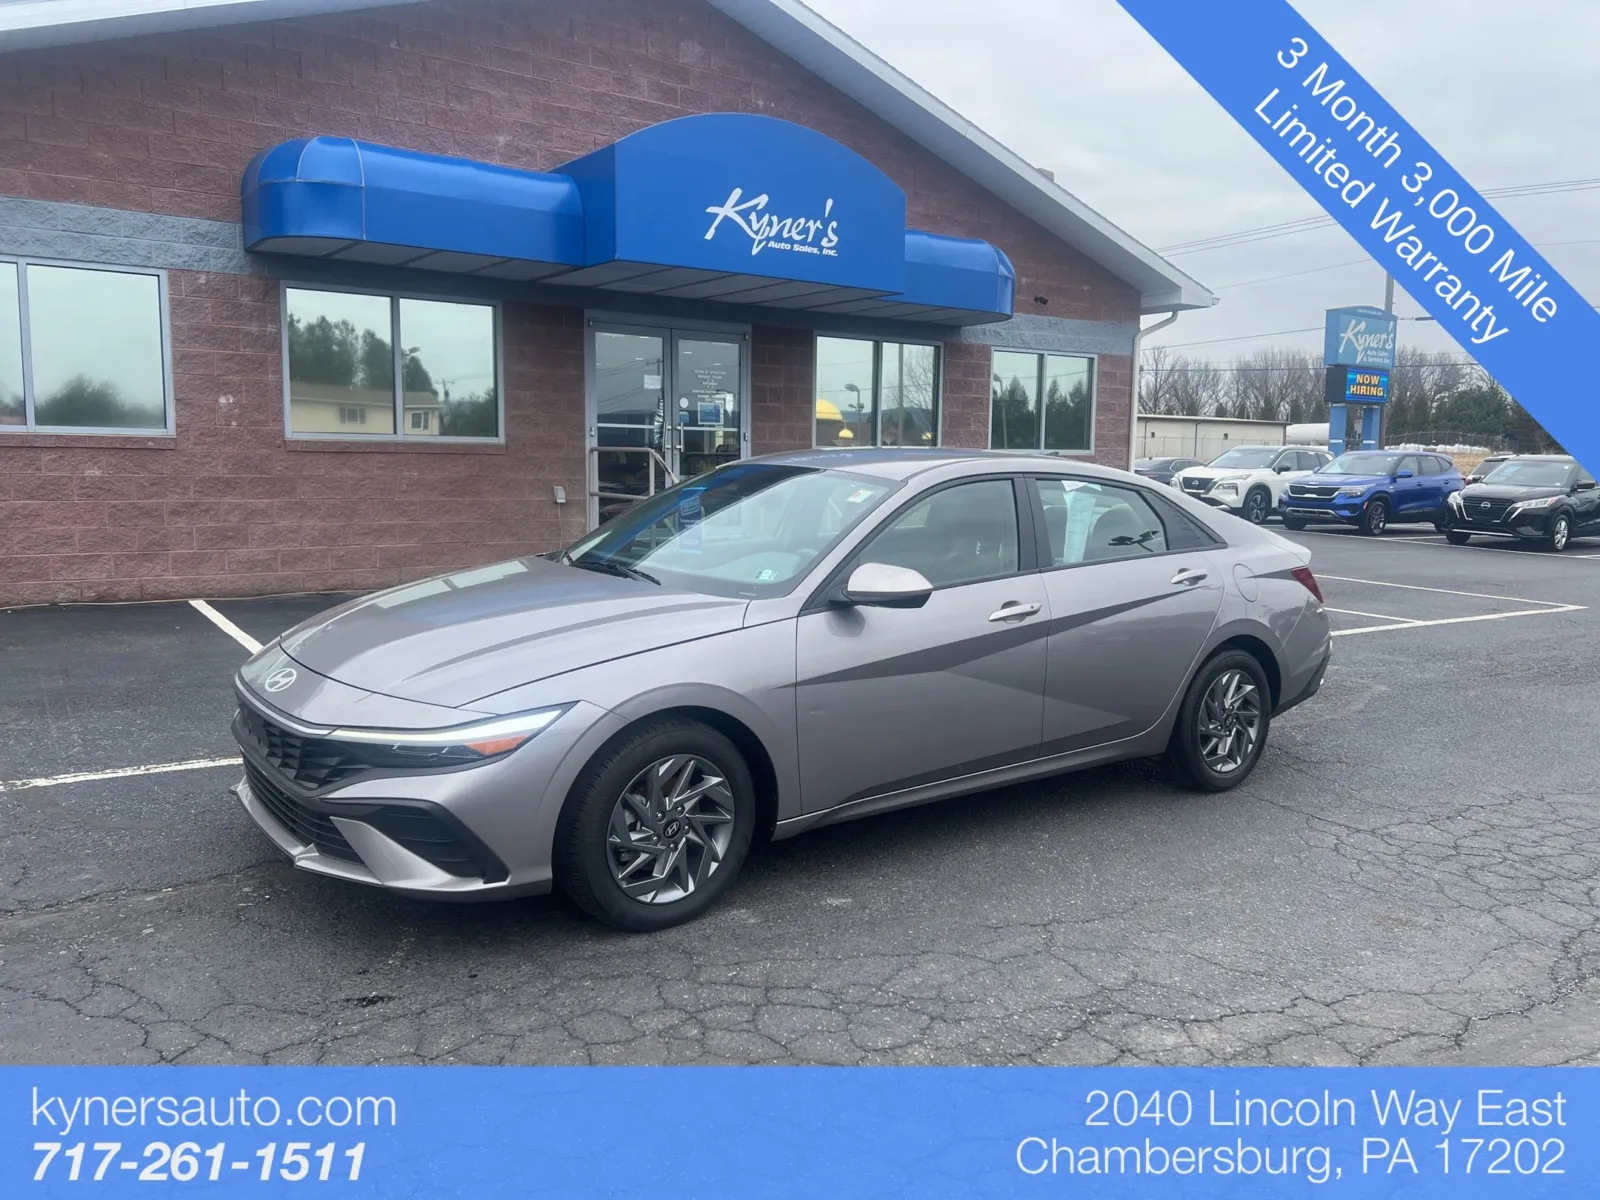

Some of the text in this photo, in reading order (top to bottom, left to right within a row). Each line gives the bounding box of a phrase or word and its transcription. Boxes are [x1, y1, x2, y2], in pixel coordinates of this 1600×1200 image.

[704, 187, 839, 256] Kyner's
[767, 240, 838, 256] Auto Sales, Inc.
[1339, 318, 1395, 364] Kyner's
[1356, 374, 1380, 385] NOW
[1350, 384, 1384, 396] HIRING
